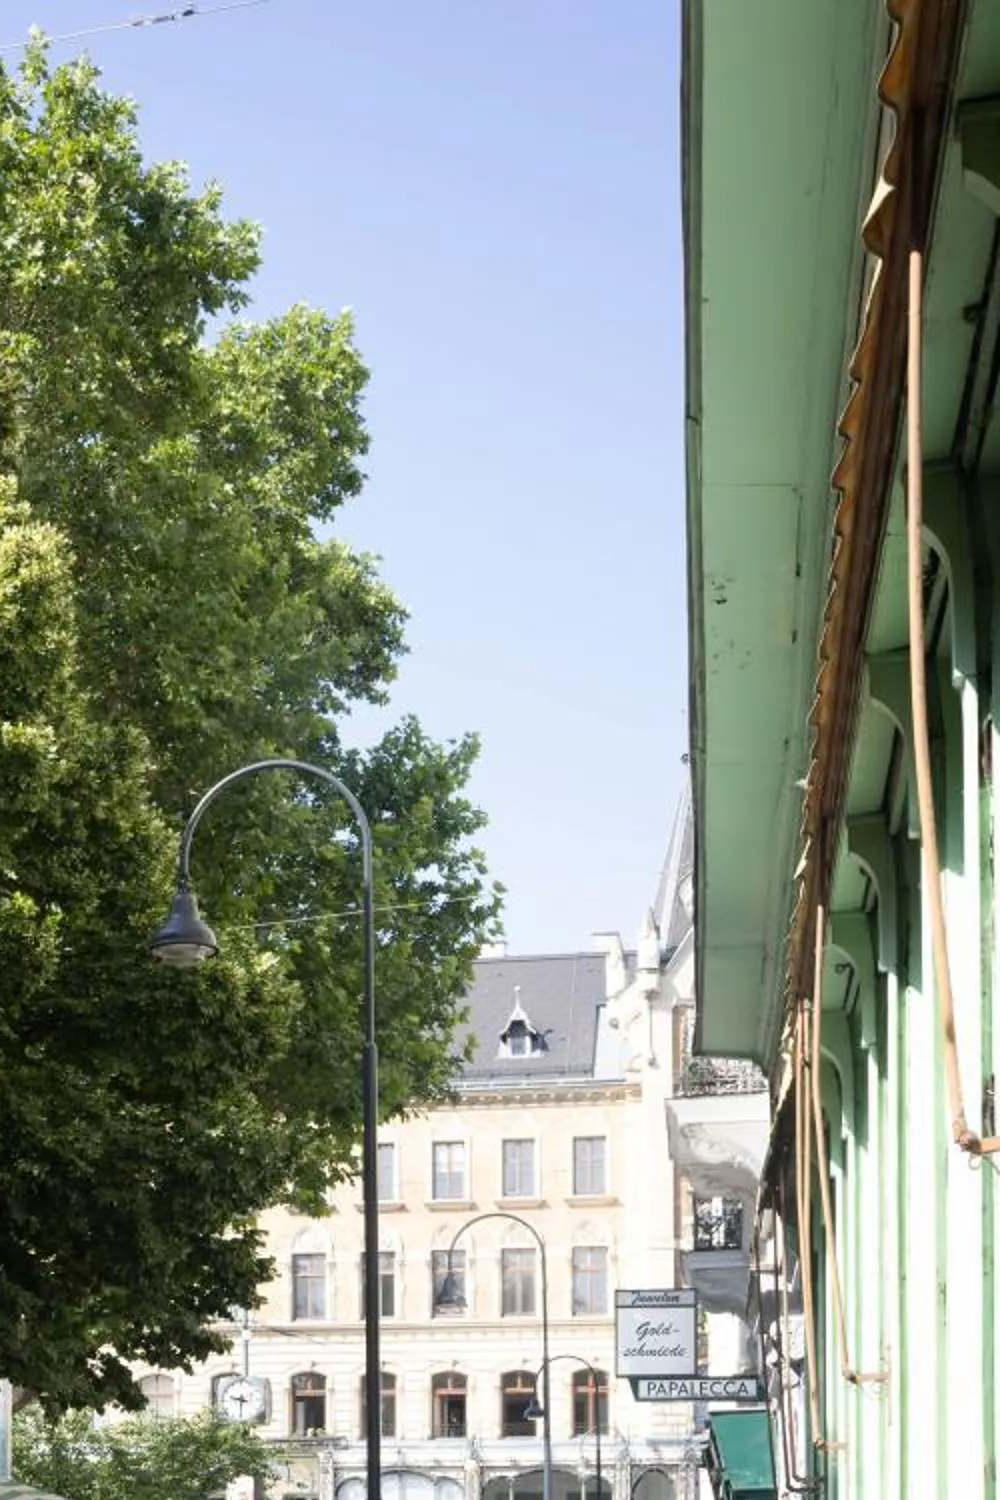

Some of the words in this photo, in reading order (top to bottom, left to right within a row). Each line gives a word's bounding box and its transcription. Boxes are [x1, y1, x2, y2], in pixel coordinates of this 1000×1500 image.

[635, 1321, 680, 1341] Gold-
[623, 1344, 686, 1358] schmiede
[647, 1381, 749, 1397] PAPALECCA
